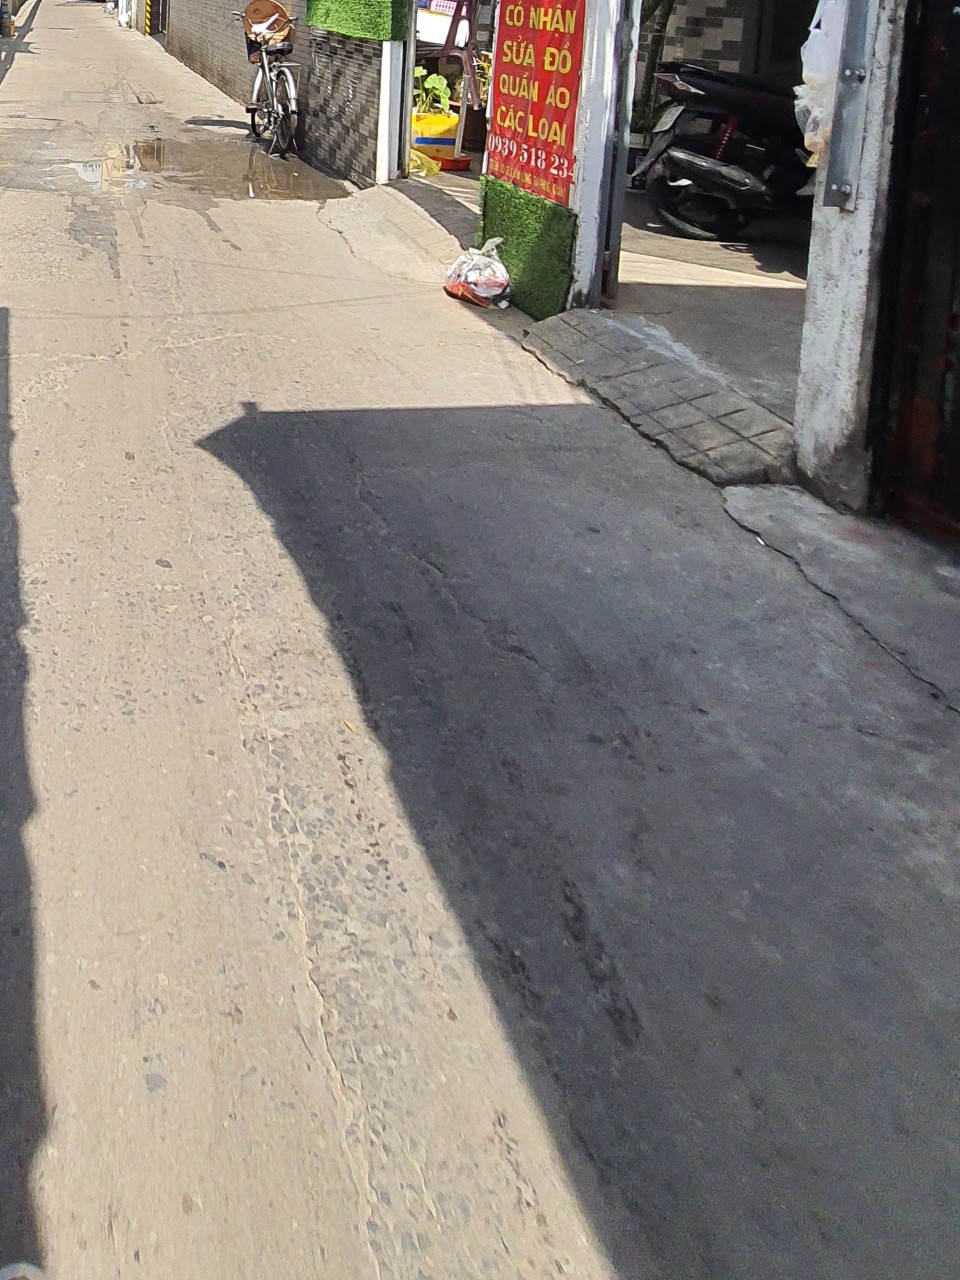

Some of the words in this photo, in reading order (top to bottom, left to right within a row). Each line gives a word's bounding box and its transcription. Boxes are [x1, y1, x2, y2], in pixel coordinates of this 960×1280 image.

[505, 1, 525, 27] CÓ
[529, 3, 576, 37] NHẬN
[502, 35, 535, 67] SỬA
[543, 41, 572, 74] ĐỒ
[500, 71, 539, 102] QUẦN
[545, 82, 570, 109] ÁO
[496, 104, 525, 133] CÁC
[528, 114, 567, 150] LOẠI
[488, 133, 517, 158] 0939
[519, 143, 546, 170] 518
